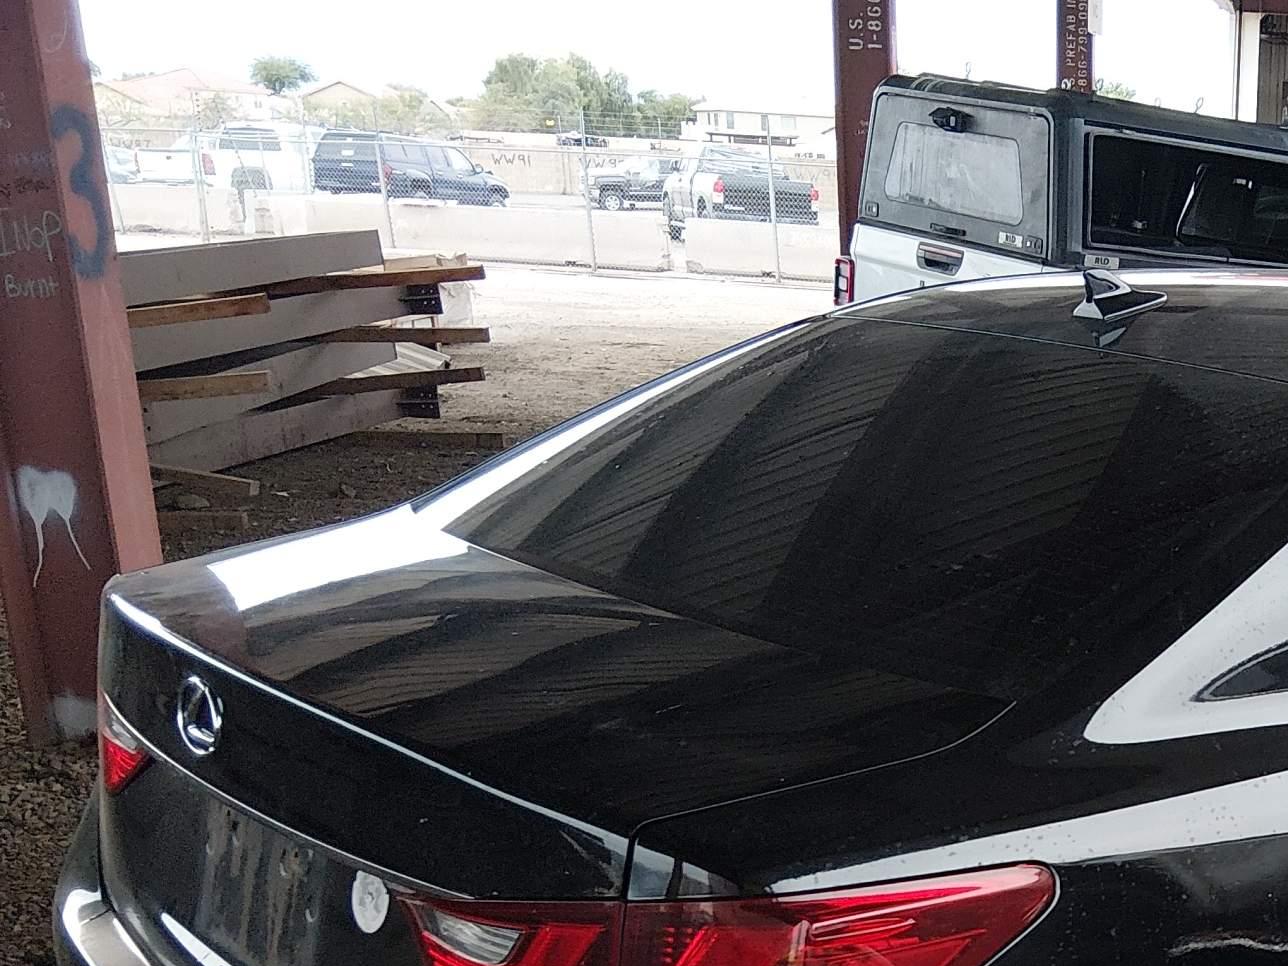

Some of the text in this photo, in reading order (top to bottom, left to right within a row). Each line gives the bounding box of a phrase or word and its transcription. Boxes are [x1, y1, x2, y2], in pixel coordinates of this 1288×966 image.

[848, 12, 864, 50] U.S.
[867, 0, 883, 49] 1-86
[1065, 15, 1076, 66] PREFAB
[51, 106, 110, 280] 3
[4, 273, 59, 300] Burnt
